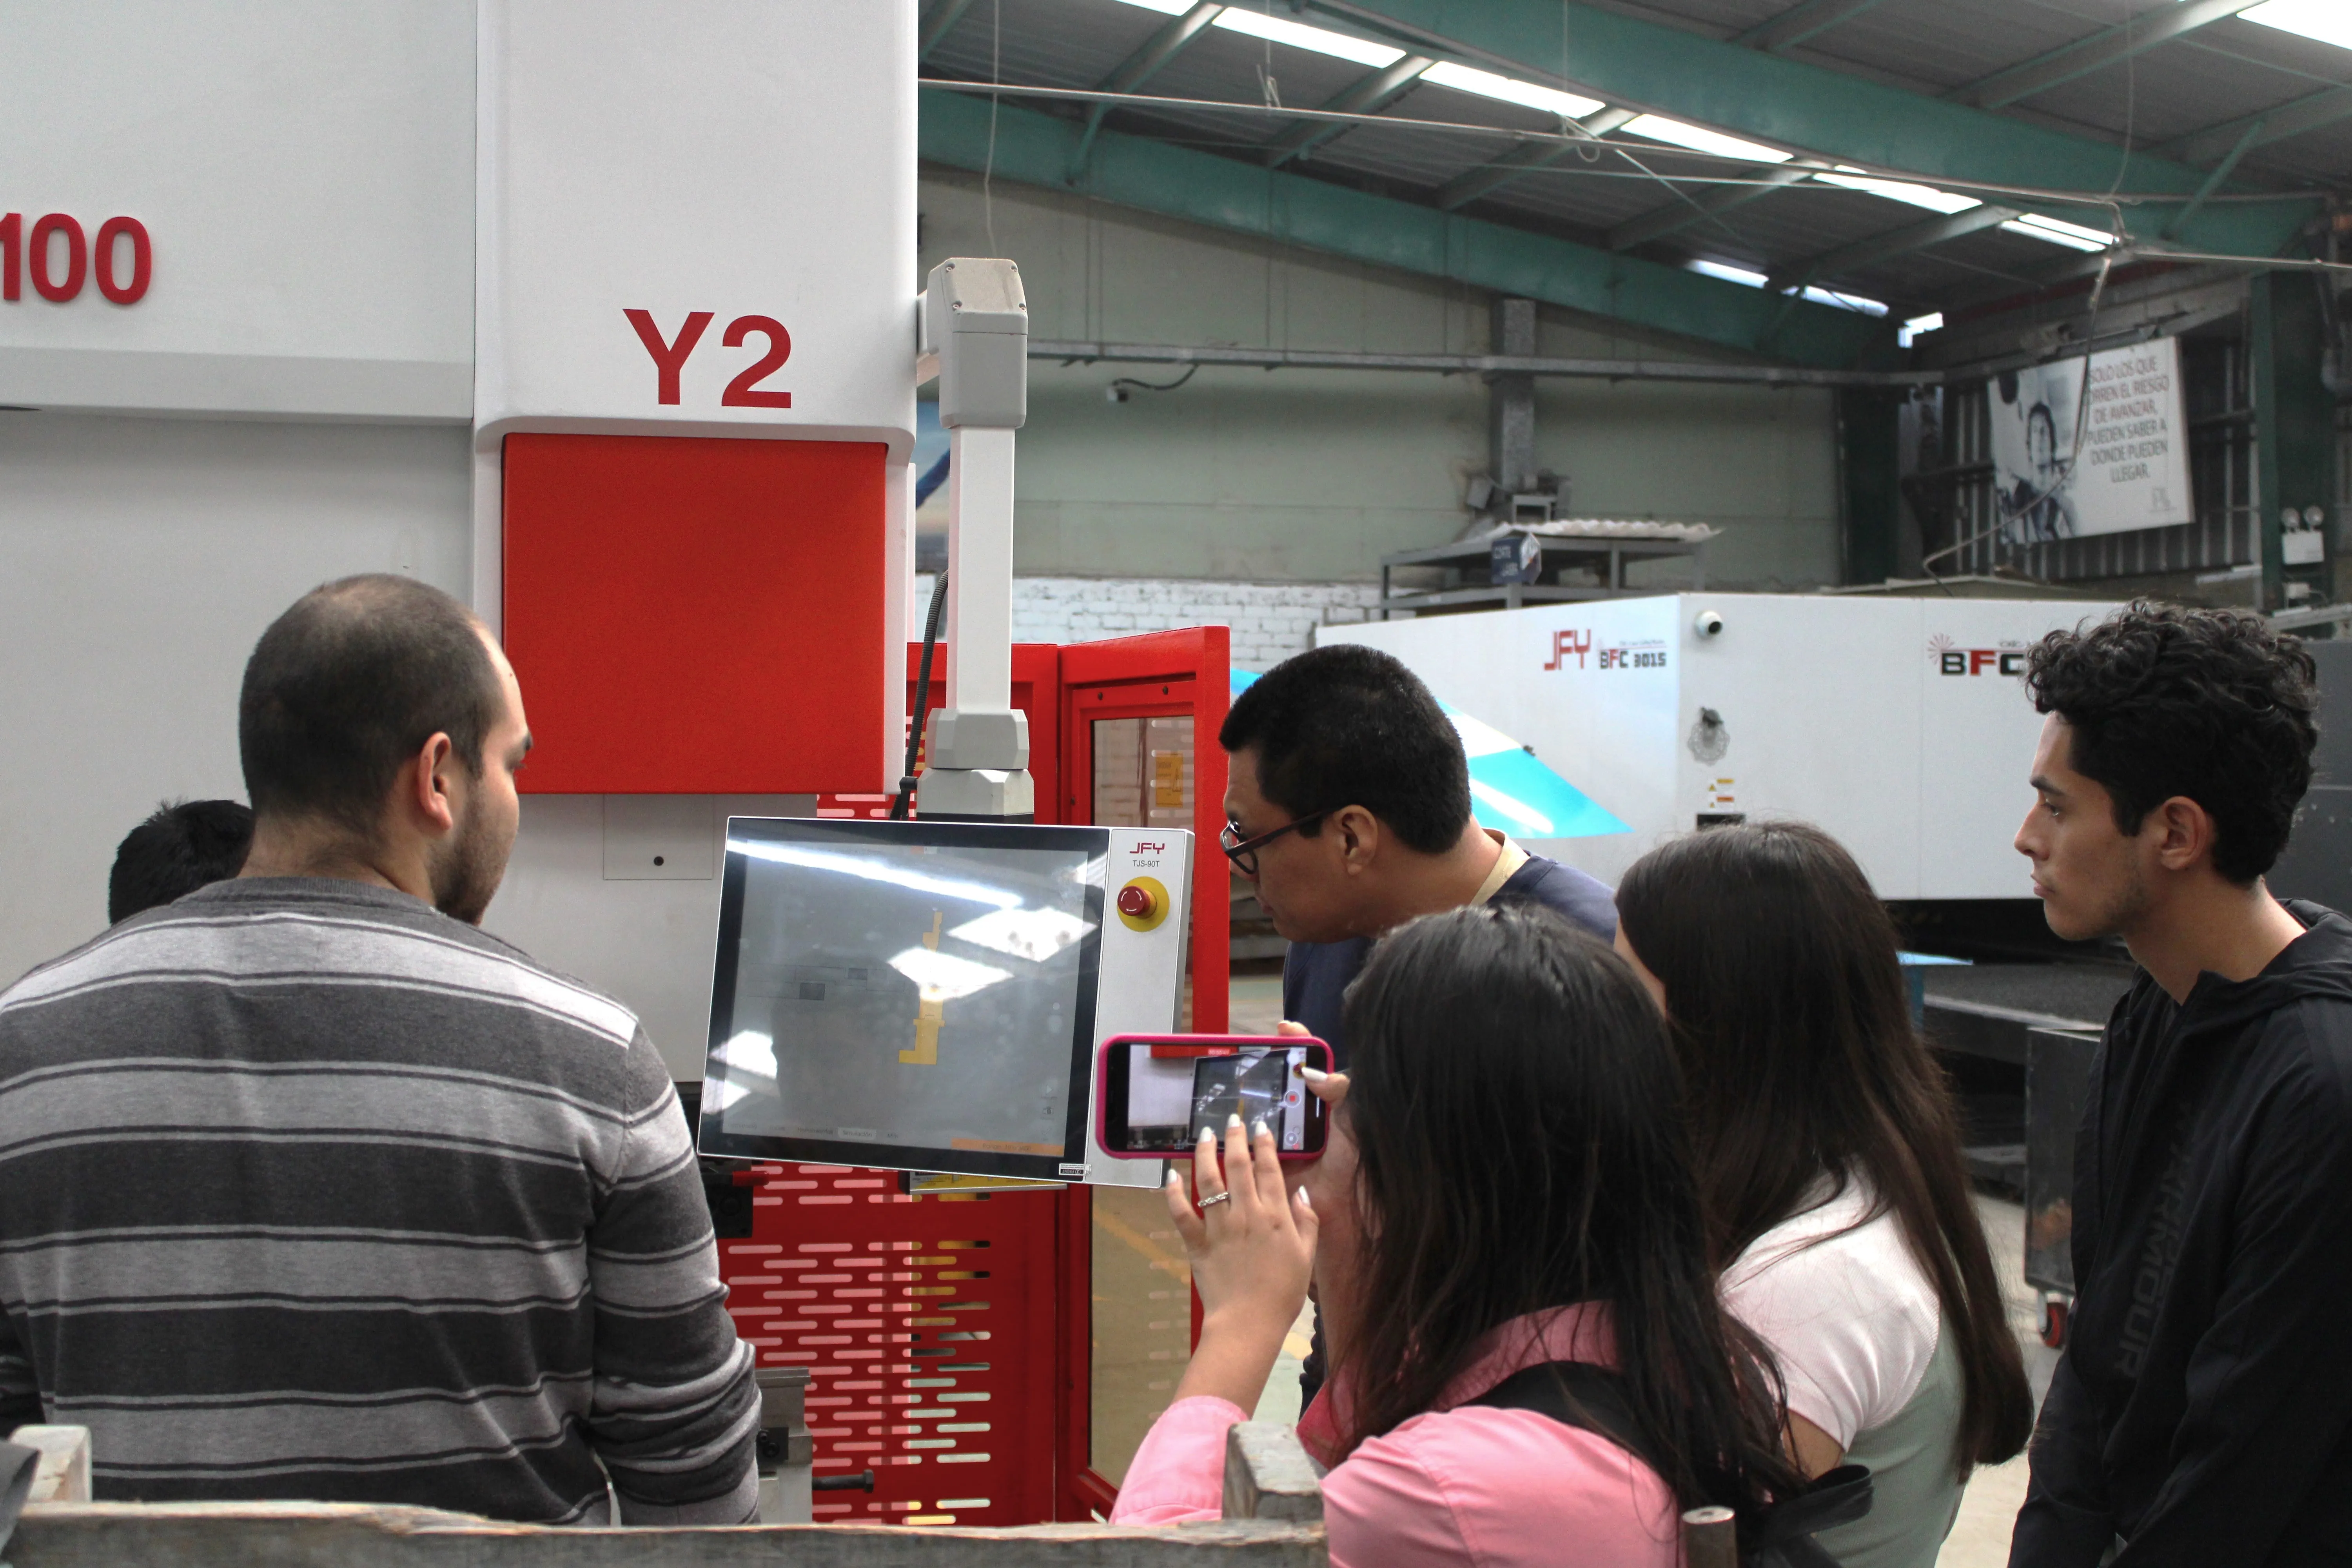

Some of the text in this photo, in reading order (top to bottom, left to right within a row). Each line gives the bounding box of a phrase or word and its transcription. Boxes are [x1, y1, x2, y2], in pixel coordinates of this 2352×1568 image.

[0, 212, 152, 305] 100
[622, 309, 791, 408] Y2
[2136, 356, 2157, 375] QUE
[2120, 382, 2132, 399] EL
[2133, 375, 2170, 394] RIESGO
[2094, 407, 2107, 424] DE
[2087, 418, 2168, 446] PUEDEN SABER A
[2089, 440, 2168, 466] DONDE PUEDEN
[1544, 629, 1591, 671] JFY
[1599, 649, 1666, 669] BFC 3015
[1942, 650, 2024, 676] BFC
[1129, 842, 1165, 854] JFY
